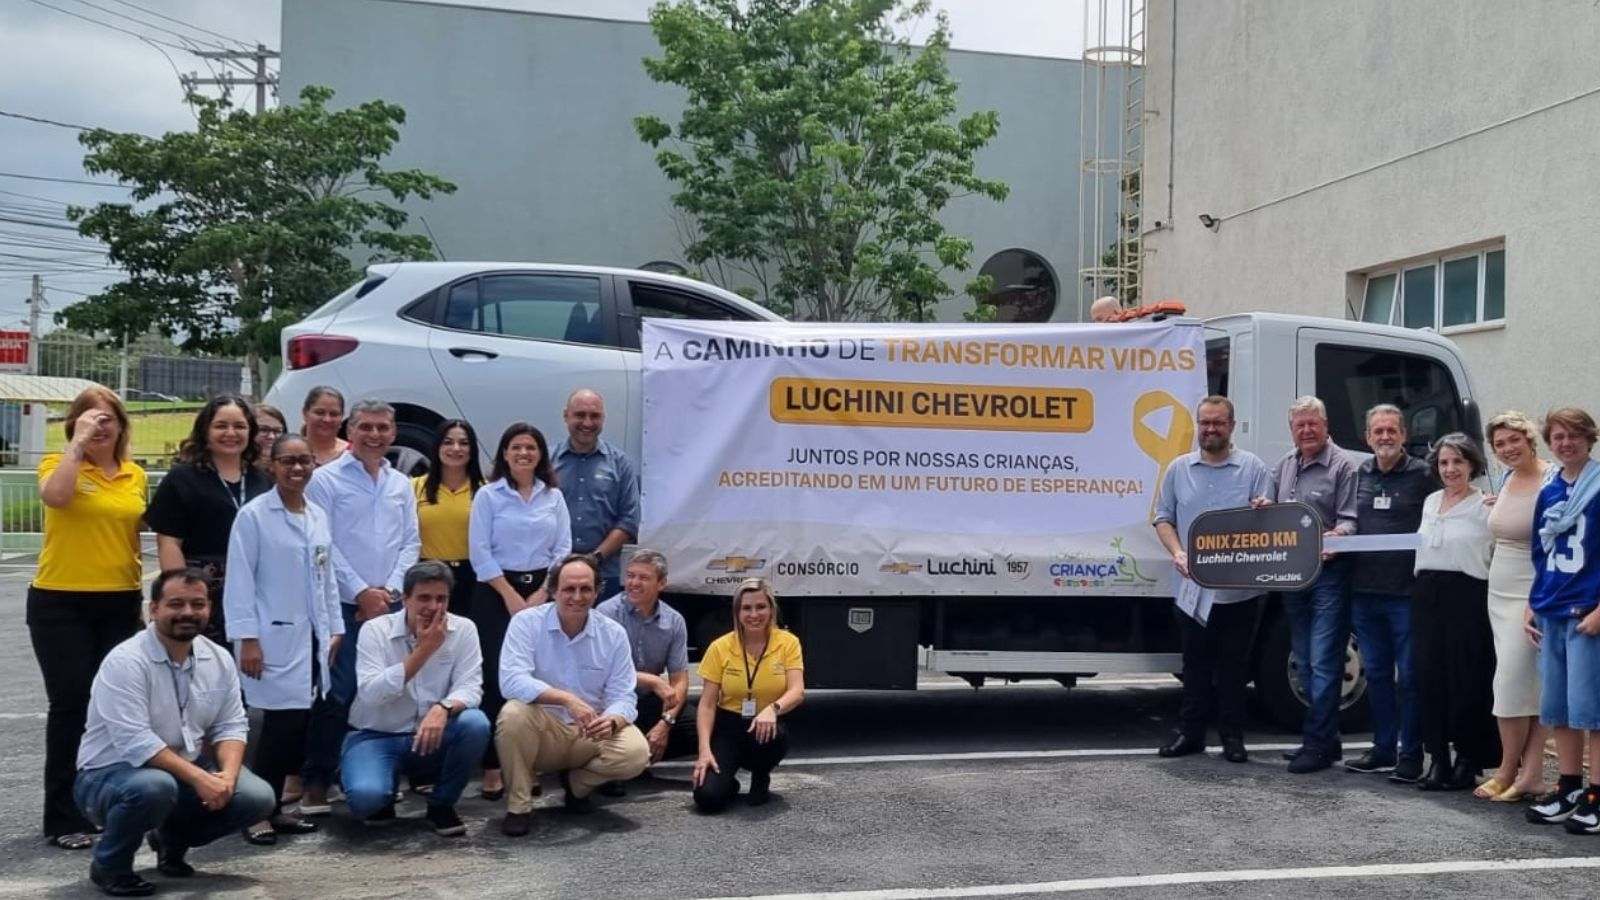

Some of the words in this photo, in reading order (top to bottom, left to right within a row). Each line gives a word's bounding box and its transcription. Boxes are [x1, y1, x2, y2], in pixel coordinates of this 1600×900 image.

[655, 342, 674, 360] A
[839, 339, 875, 361] DE
[885, 339, 1105, 369] TRANSFORMAR
[1112, 348, 1195, 371] VIDAS
[786, 386, 903, 414] LUCHINI
[911, 391, 1077, 420] CHEVROLET
[787, 448, 858, 466] JUNTOS
[863, 450, 900, 467] POR
[905, 451, 978, 468] NOSSAS
[984, 453, 1078, 474] CRIANÇAS,
[718, 471, 853, 490] ACREDITANDO
[858, 474, 885, 490] EM
[890, 475, 921, 491] UM
[926, 476, 998, 492] FUTURO
[1003, 478, 1026, 493] DE
[1031, 479, 1143, 498] ESPERANÇA!
[1196, 535, 1230, 550] ONIX
[1232, 533, 1269, 549] ZERO
[1273, 532, 1297, 547] KM
[1197, 552, 1233, 564] Luchini
[1236, 550, 1287, 563] Chevrolet
[778, 559, 859, 575] CONSÓRCIO
[927, 558, 996, 575] Luchini
[1008, 561, 1029, 573] 1957
[1049, 563, 1119, 578] CRIANÇA
